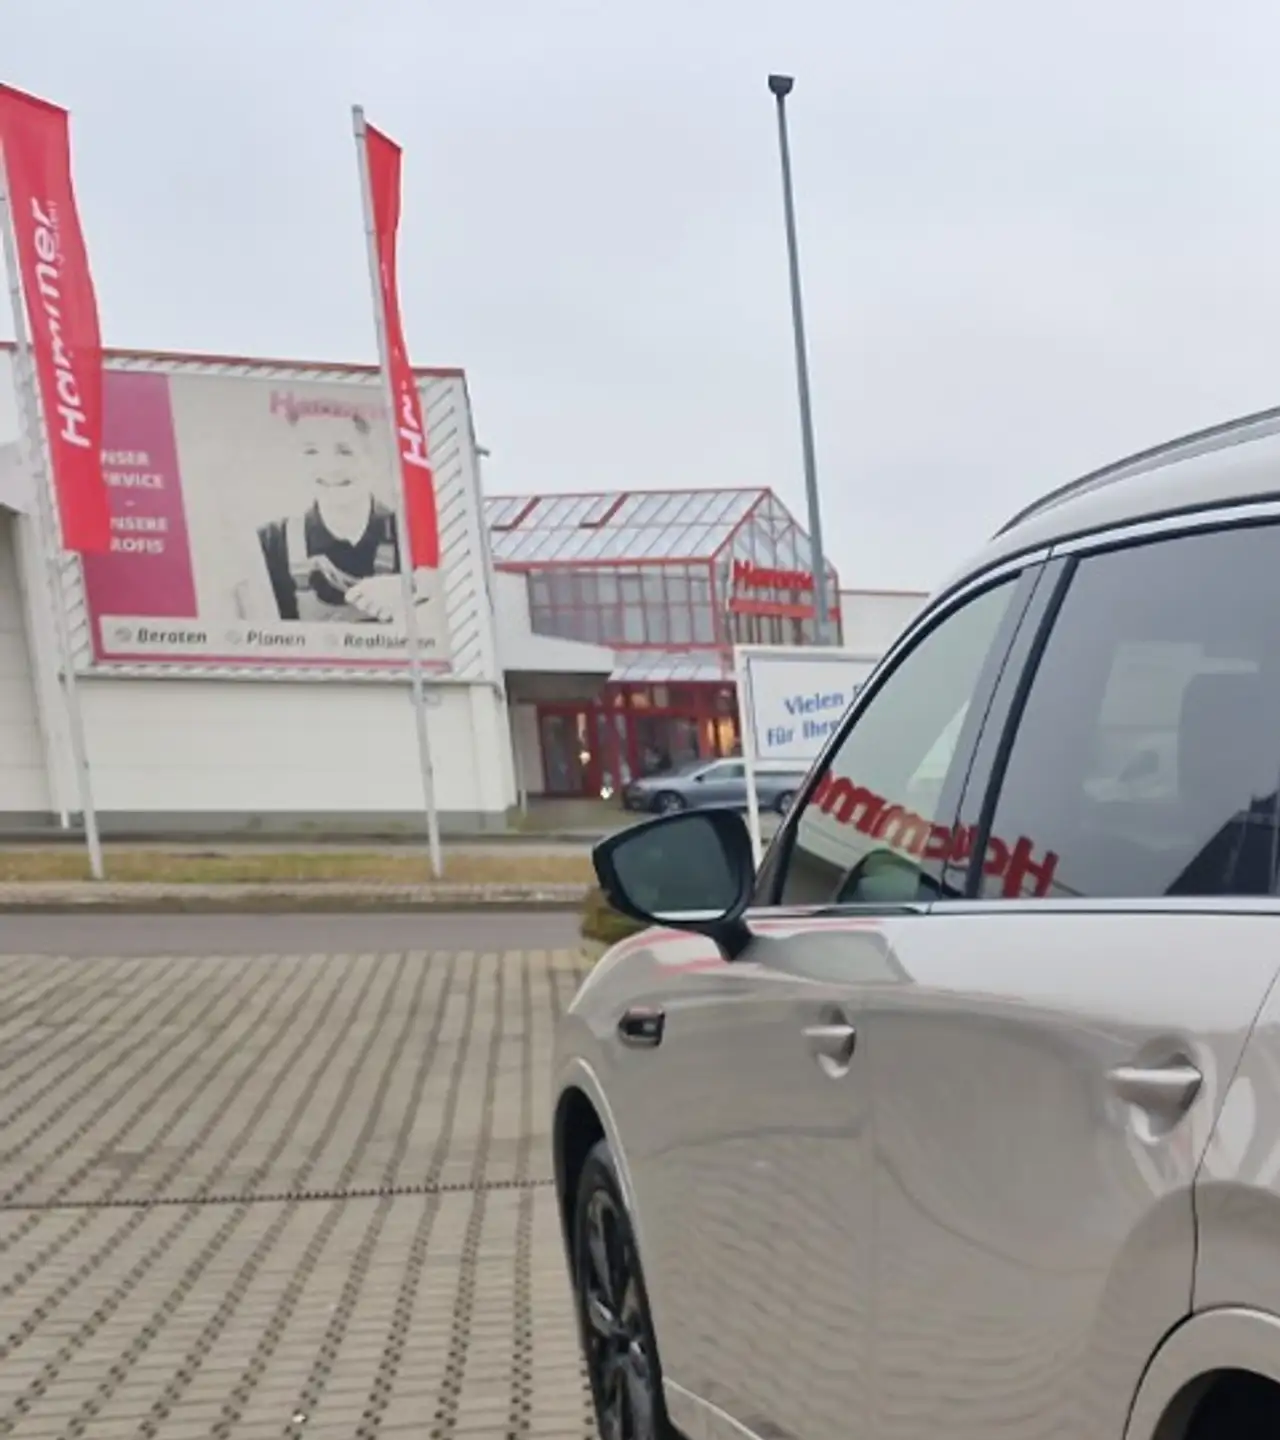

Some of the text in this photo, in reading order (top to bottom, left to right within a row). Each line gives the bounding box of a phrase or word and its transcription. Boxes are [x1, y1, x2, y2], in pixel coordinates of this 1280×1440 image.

[100, 449, 149, 466] NSER
[110, 516, 168, 533] NSERE
[137, 627, 207, 644] Beraten
[246, 629, 306, 648] Planen
[784, 691, 845, 716] Vielen
